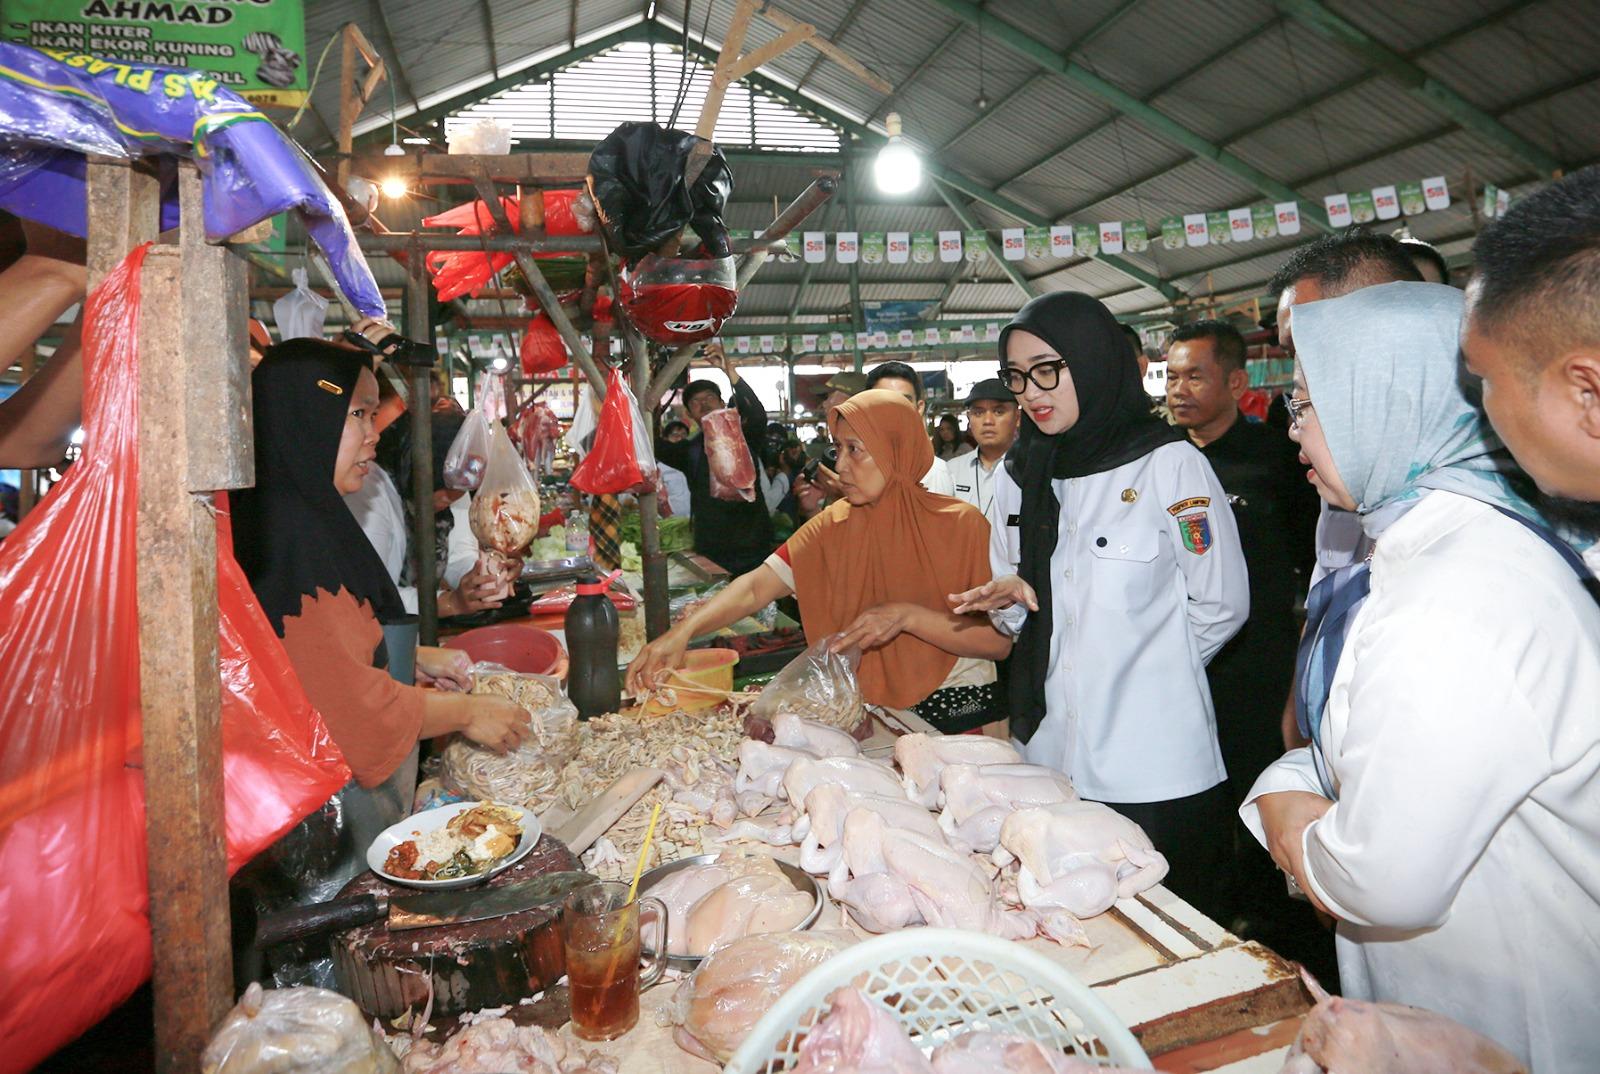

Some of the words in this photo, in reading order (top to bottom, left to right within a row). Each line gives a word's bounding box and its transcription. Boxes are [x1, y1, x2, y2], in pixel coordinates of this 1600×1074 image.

[82, 0, 233, 24] AHMAD
[31, 21, 84, 34] IKAN
[90, 24, 151, 38] KITER
[31, 35, 84, 48] IKAN
[90, 38, 148, 51] EKOR
[154, 42, 234, 56] KUNING
